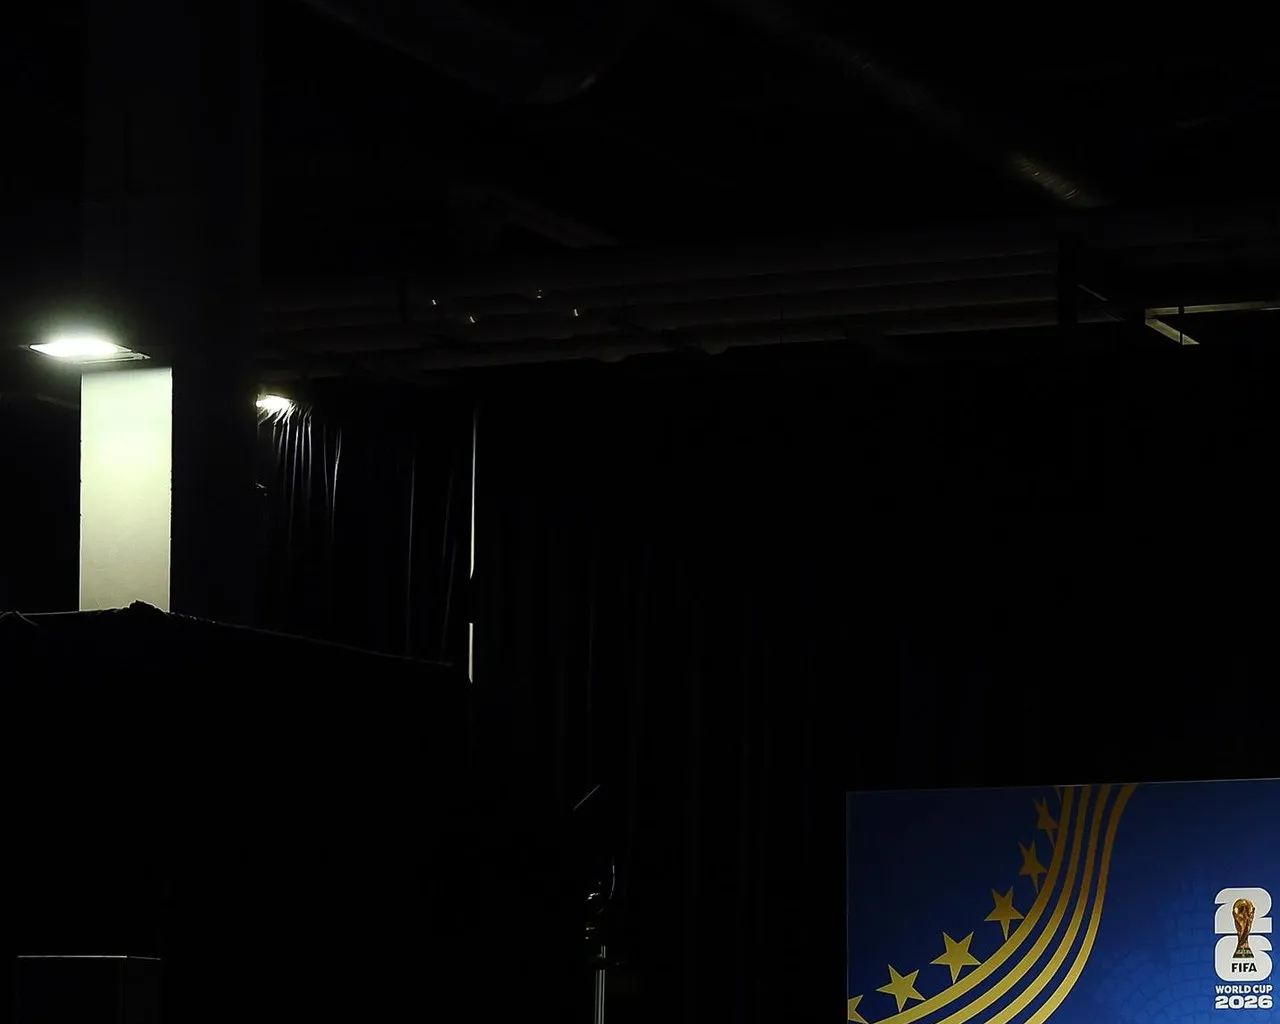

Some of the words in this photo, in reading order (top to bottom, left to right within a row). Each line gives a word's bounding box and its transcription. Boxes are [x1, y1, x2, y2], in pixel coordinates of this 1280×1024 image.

[1232, 963, 1257, 972] FIFA
[1216, 985, 1251, 993] WORLD
[1253, 985, 1272, 993] CUP
[1215, 995, 1273, 1009] 2026
